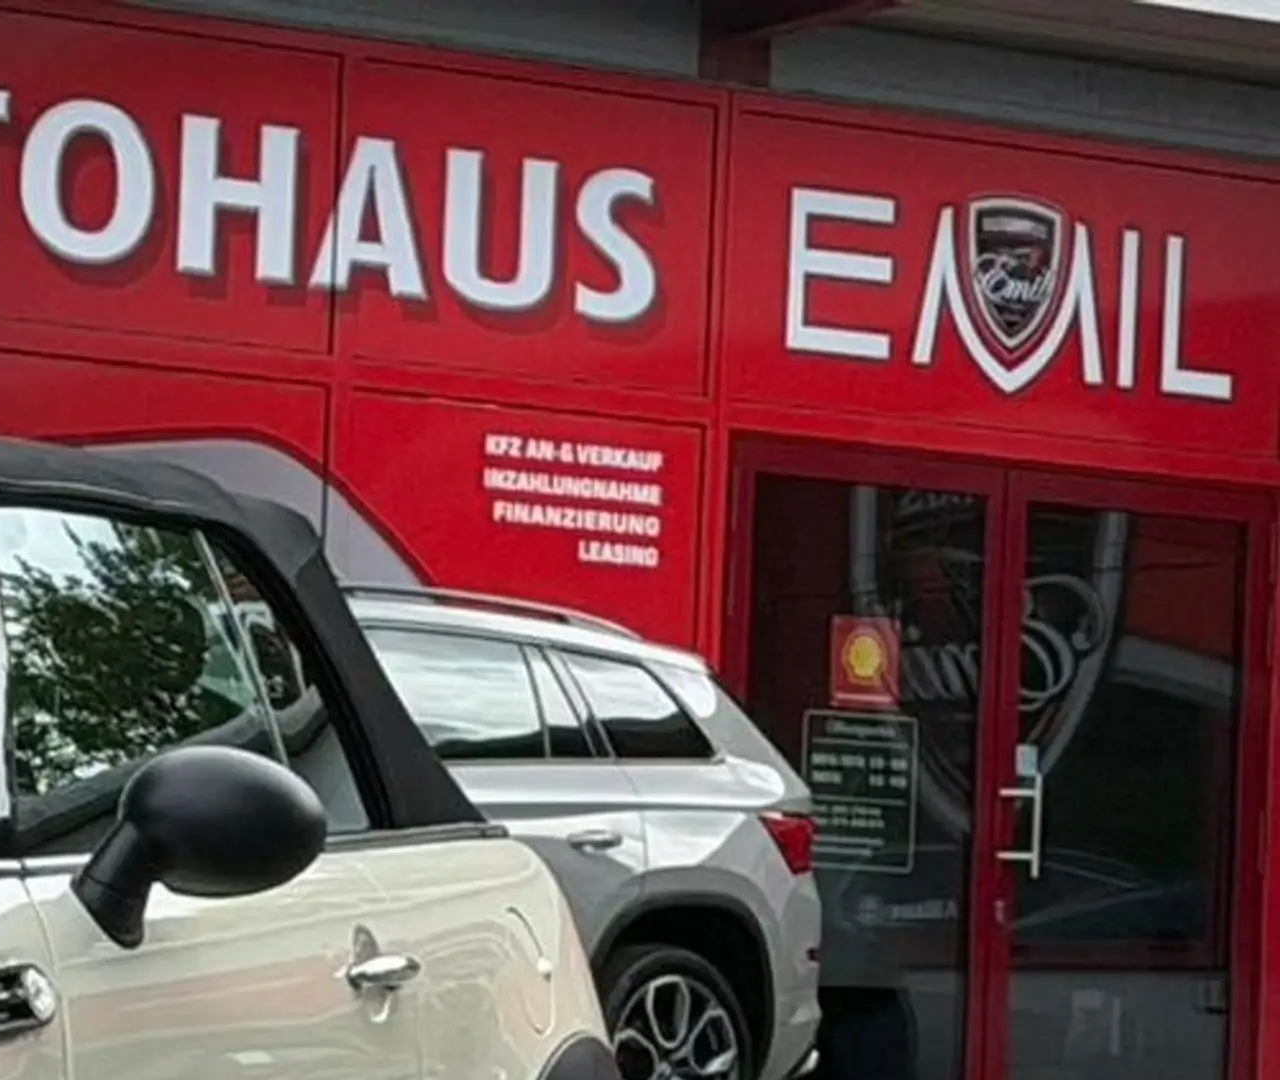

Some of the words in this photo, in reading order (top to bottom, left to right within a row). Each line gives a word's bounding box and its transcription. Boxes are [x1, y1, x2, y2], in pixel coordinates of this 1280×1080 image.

[784, 185, 1233, 400] EMIL
[484, 433, 522, 458] KFZ
[576, 443, 664, 472] VERKAUF
[483, 467, 662, 505] INZAHLUNGNAHME
[493, 500, 661, 537] FINANZIERUNG
[577, 540, 660, 568] LEASING
